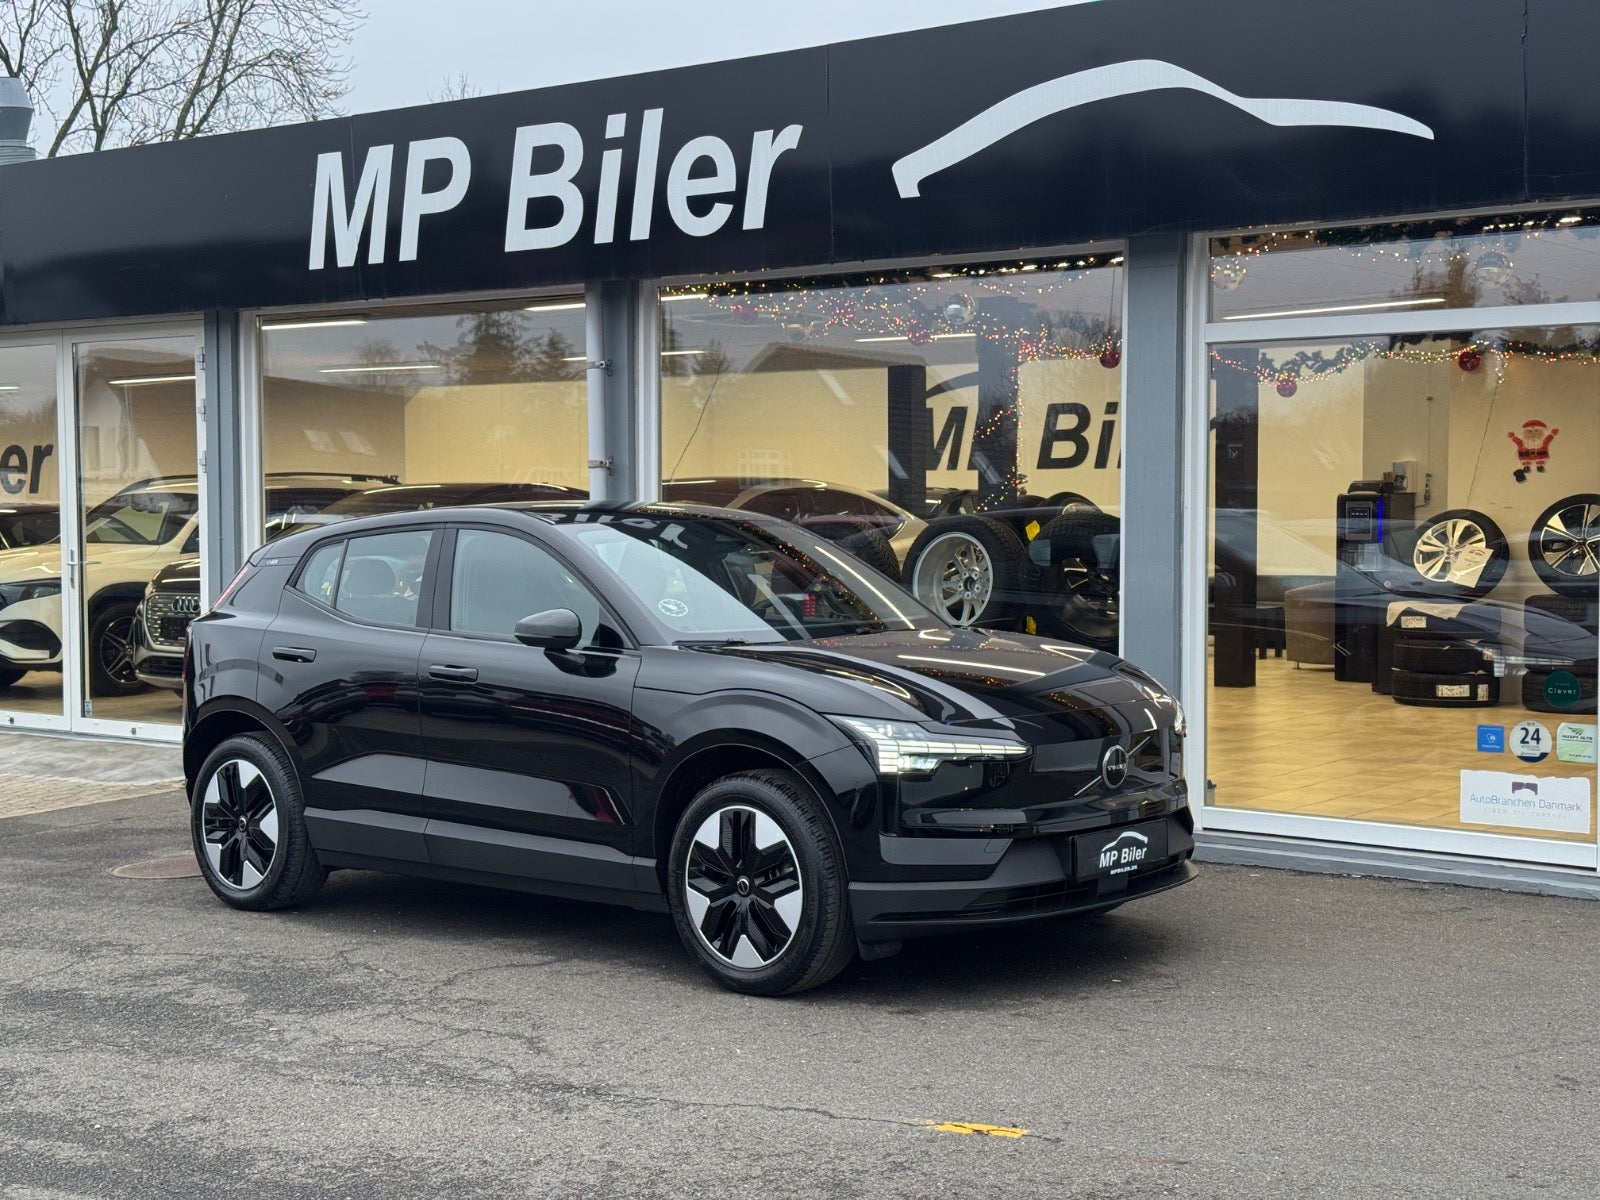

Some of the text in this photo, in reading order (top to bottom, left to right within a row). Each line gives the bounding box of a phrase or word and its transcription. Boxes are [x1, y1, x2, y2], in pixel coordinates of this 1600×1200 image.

[308, 107, 804, 271] MP Biler
[1547, 687, 1577, 695] Clever
[1519, 727, 1542, 745] 24
[1470, 793, 1582, 812] AutoBranchen Danmark
[1099, 846, 1147, 869] MP Biler
